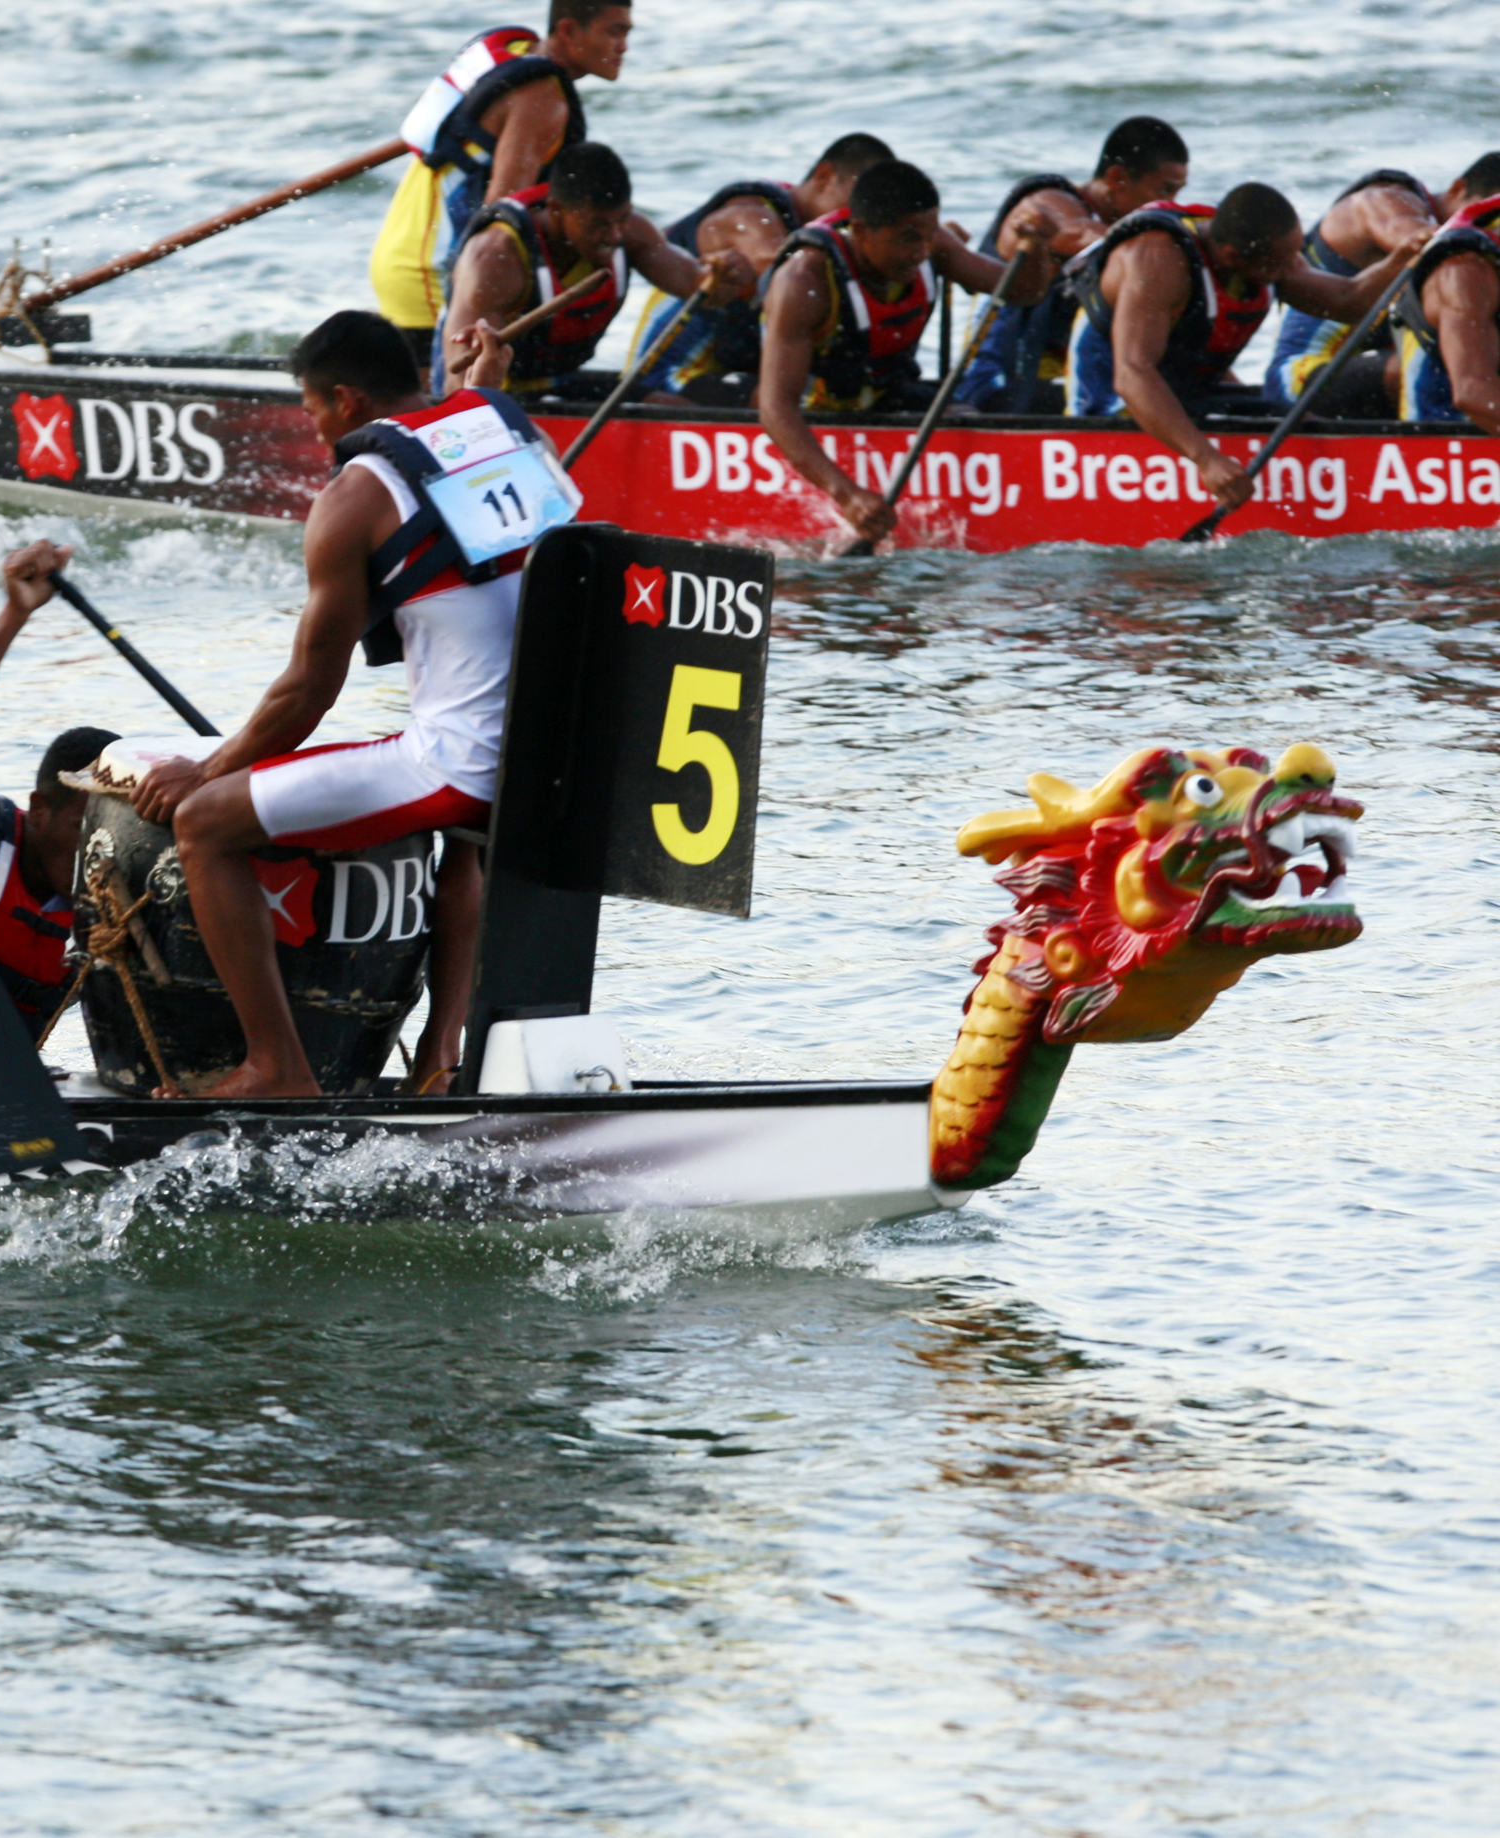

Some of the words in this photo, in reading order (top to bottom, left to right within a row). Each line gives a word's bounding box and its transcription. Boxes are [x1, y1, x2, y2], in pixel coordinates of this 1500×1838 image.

[78, 398, 225, 485] DBS
[822, 431, 1020, 516] iving,
[1369, 440, 1500, 505] Asia
[482, 481, 527, 528] 11
[668, 570, 764, 640] DBS
[651, 664, 742, 866] 5
